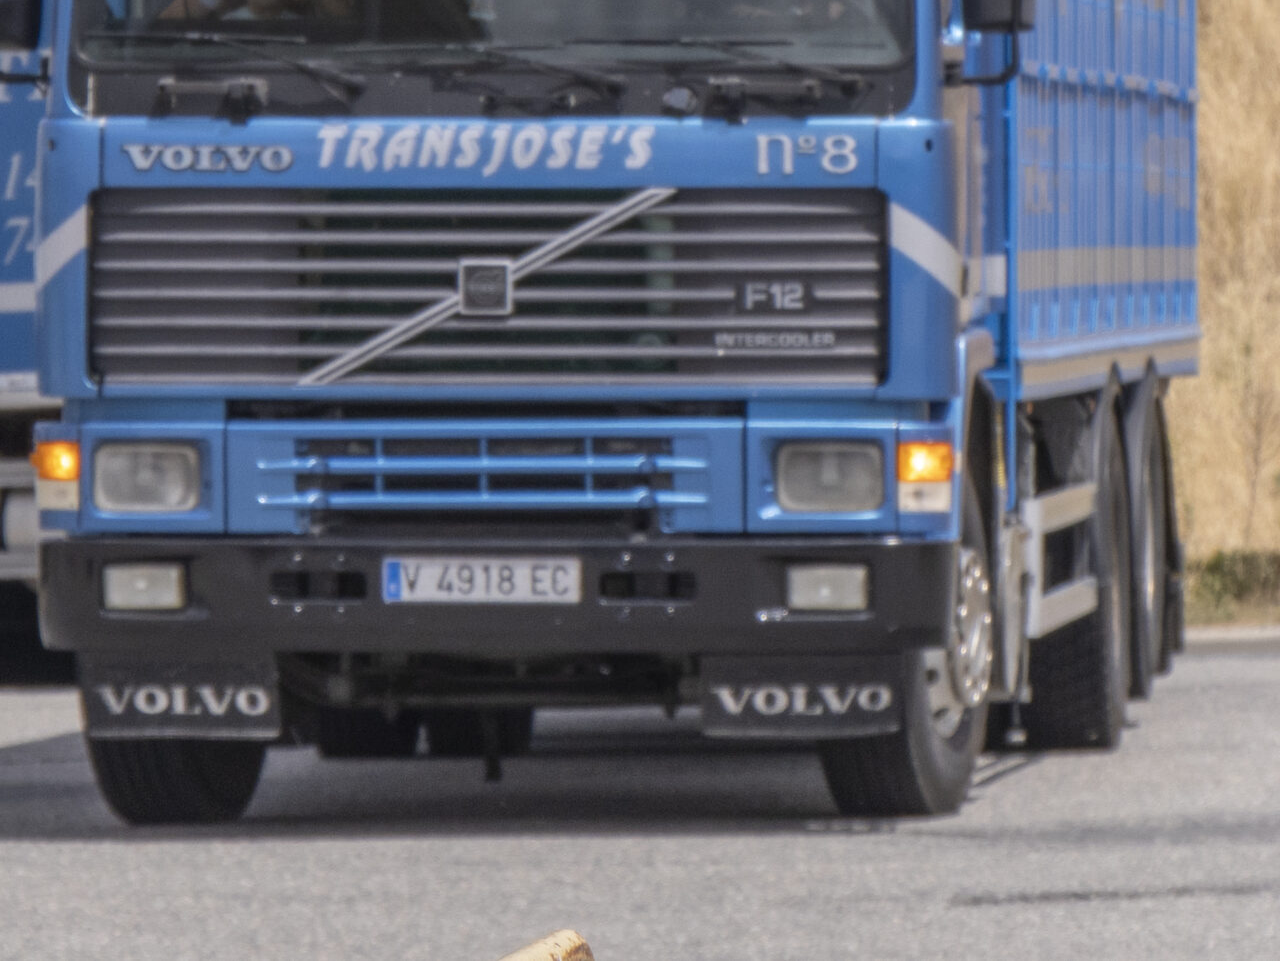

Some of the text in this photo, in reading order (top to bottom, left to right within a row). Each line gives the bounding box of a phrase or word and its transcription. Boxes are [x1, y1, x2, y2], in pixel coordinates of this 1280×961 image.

[122, 122, 656, 177] VOLVO TRANSJOSE'S
[3, 215, 37, 266] 7
[744, 282, 805, 310] F12
[402, 562, 569, 597] V 4918 EC
[97, 683, 270, 717] VOLVO
[711, 682, 892, 716] VOLVO
